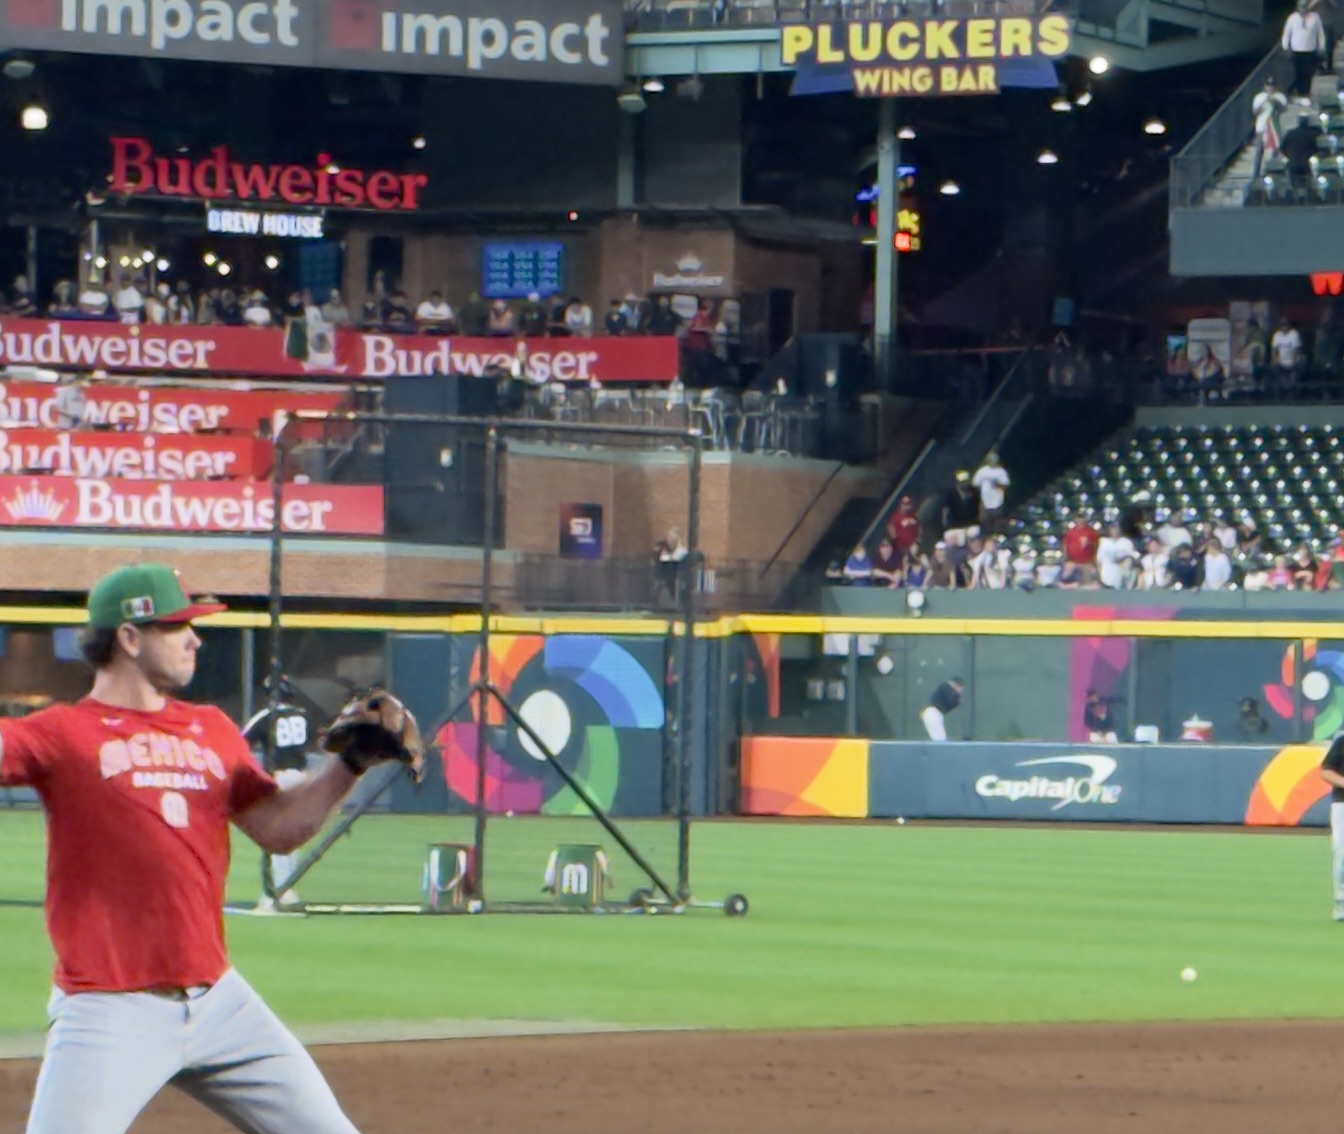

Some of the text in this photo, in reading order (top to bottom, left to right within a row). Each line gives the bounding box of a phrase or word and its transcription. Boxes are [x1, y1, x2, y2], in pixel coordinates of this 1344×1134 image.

[381, 11, 609, 69] impact
[782, 16, 1070, 64] PLUCKERS
[853, 65, 996, 93] WING BAR
[109, 137, 428, 209] Budweiser
[262, 213, 324, 238] HOUSE
[75, 479, 333, 531] Budweiser
